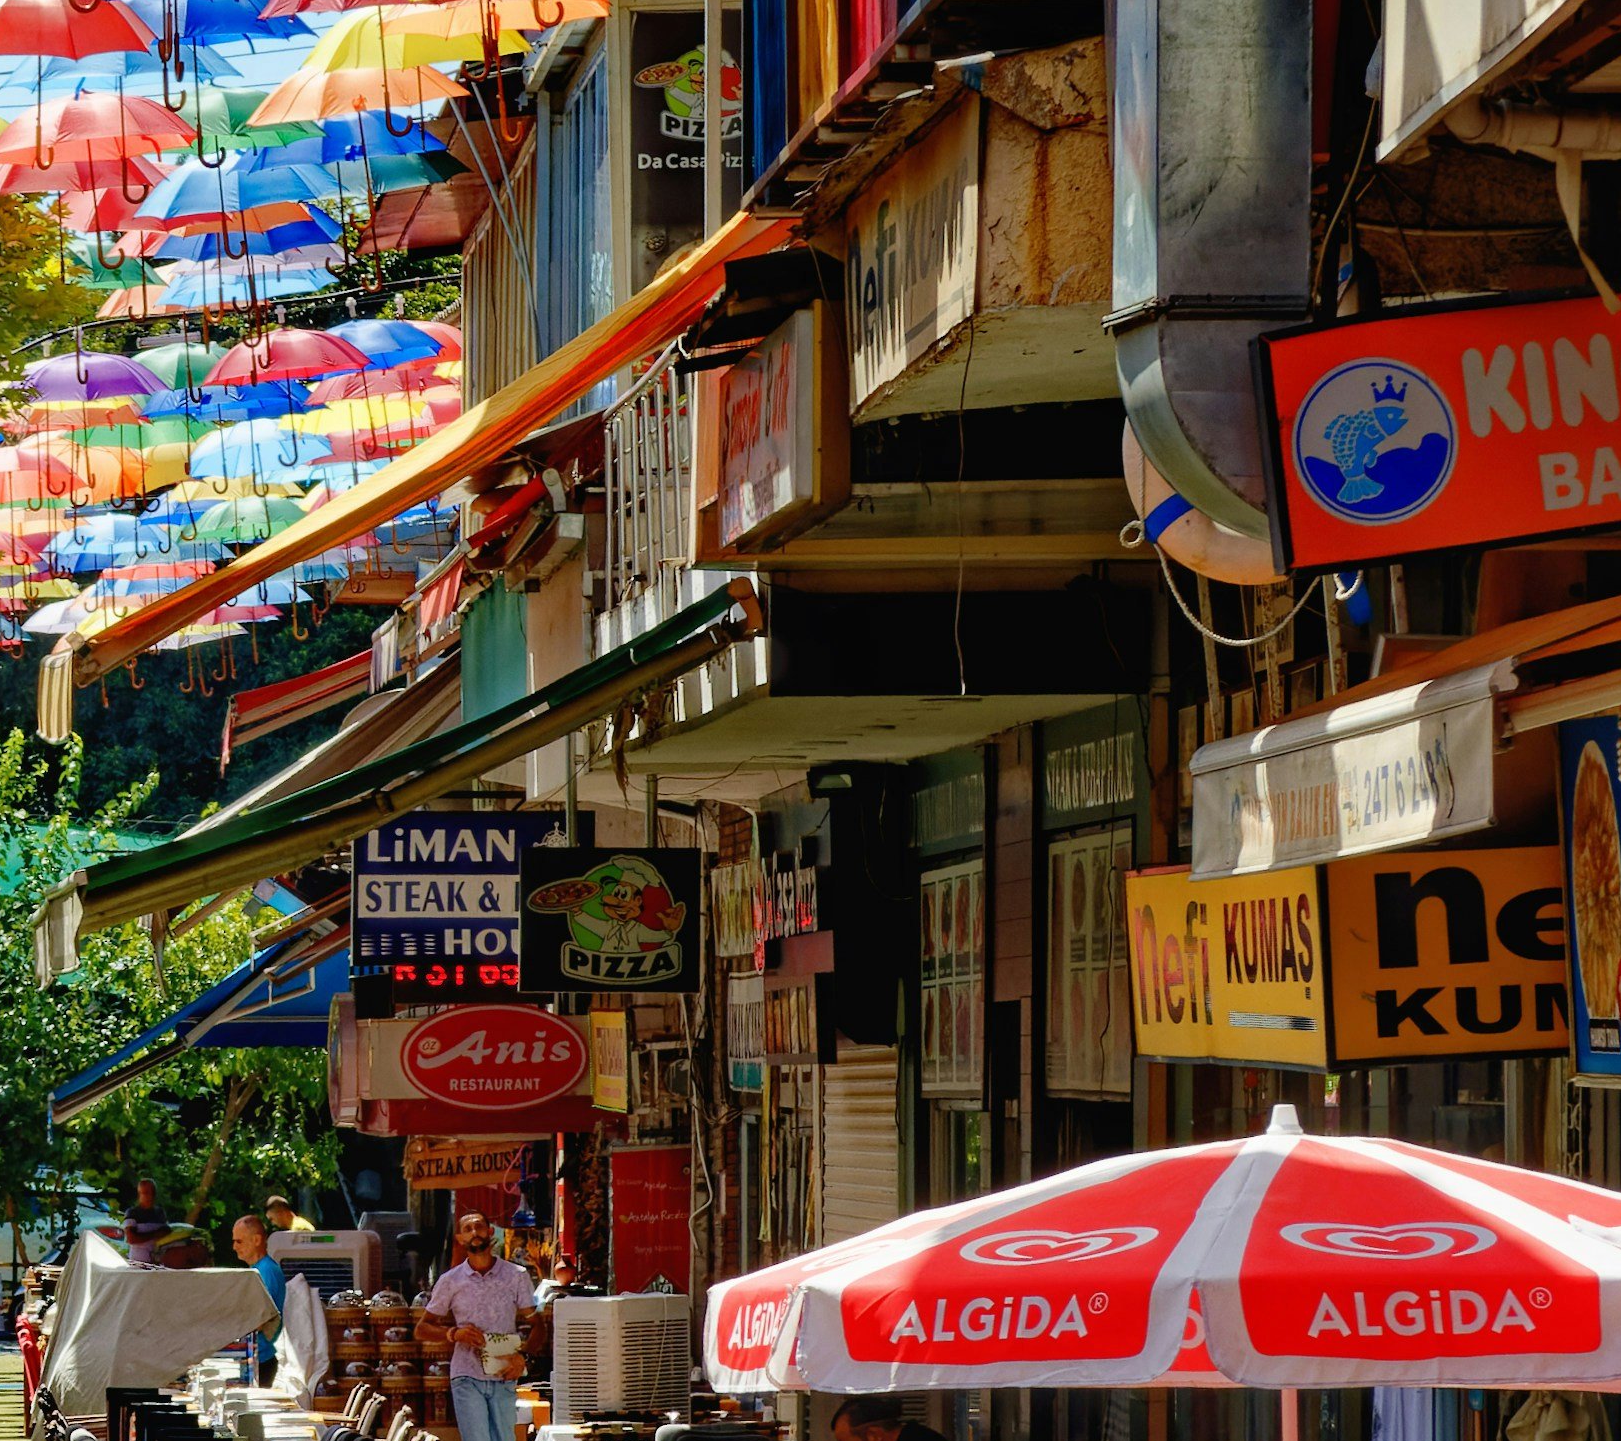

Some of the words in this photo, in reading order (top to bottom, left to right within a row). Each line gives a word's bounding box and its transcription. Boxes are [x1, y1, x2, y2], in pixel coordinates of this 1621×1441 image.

[366, 827, 517, 863] LiMAN
[365, 880, 468, 913] STEAK
[479, 880, 501, 913] &
[569, 948, 676, 981] PIZZA
[1134, 901, 1213, 1026] nefi
[1223, 892, 1314, 1000] KUMAŞ
[416, 1029, 571, 1070] Anis
[449, 1077, 541, 1092] RESTAURANT
[416, 1153, 466, 1179] STEAK
[470, 1149, 524, 1175] HOUSE
[889, 1295, 1089, 1345] ALGiDA
[1308, 1286, 1536, 1341] ALGiDA
